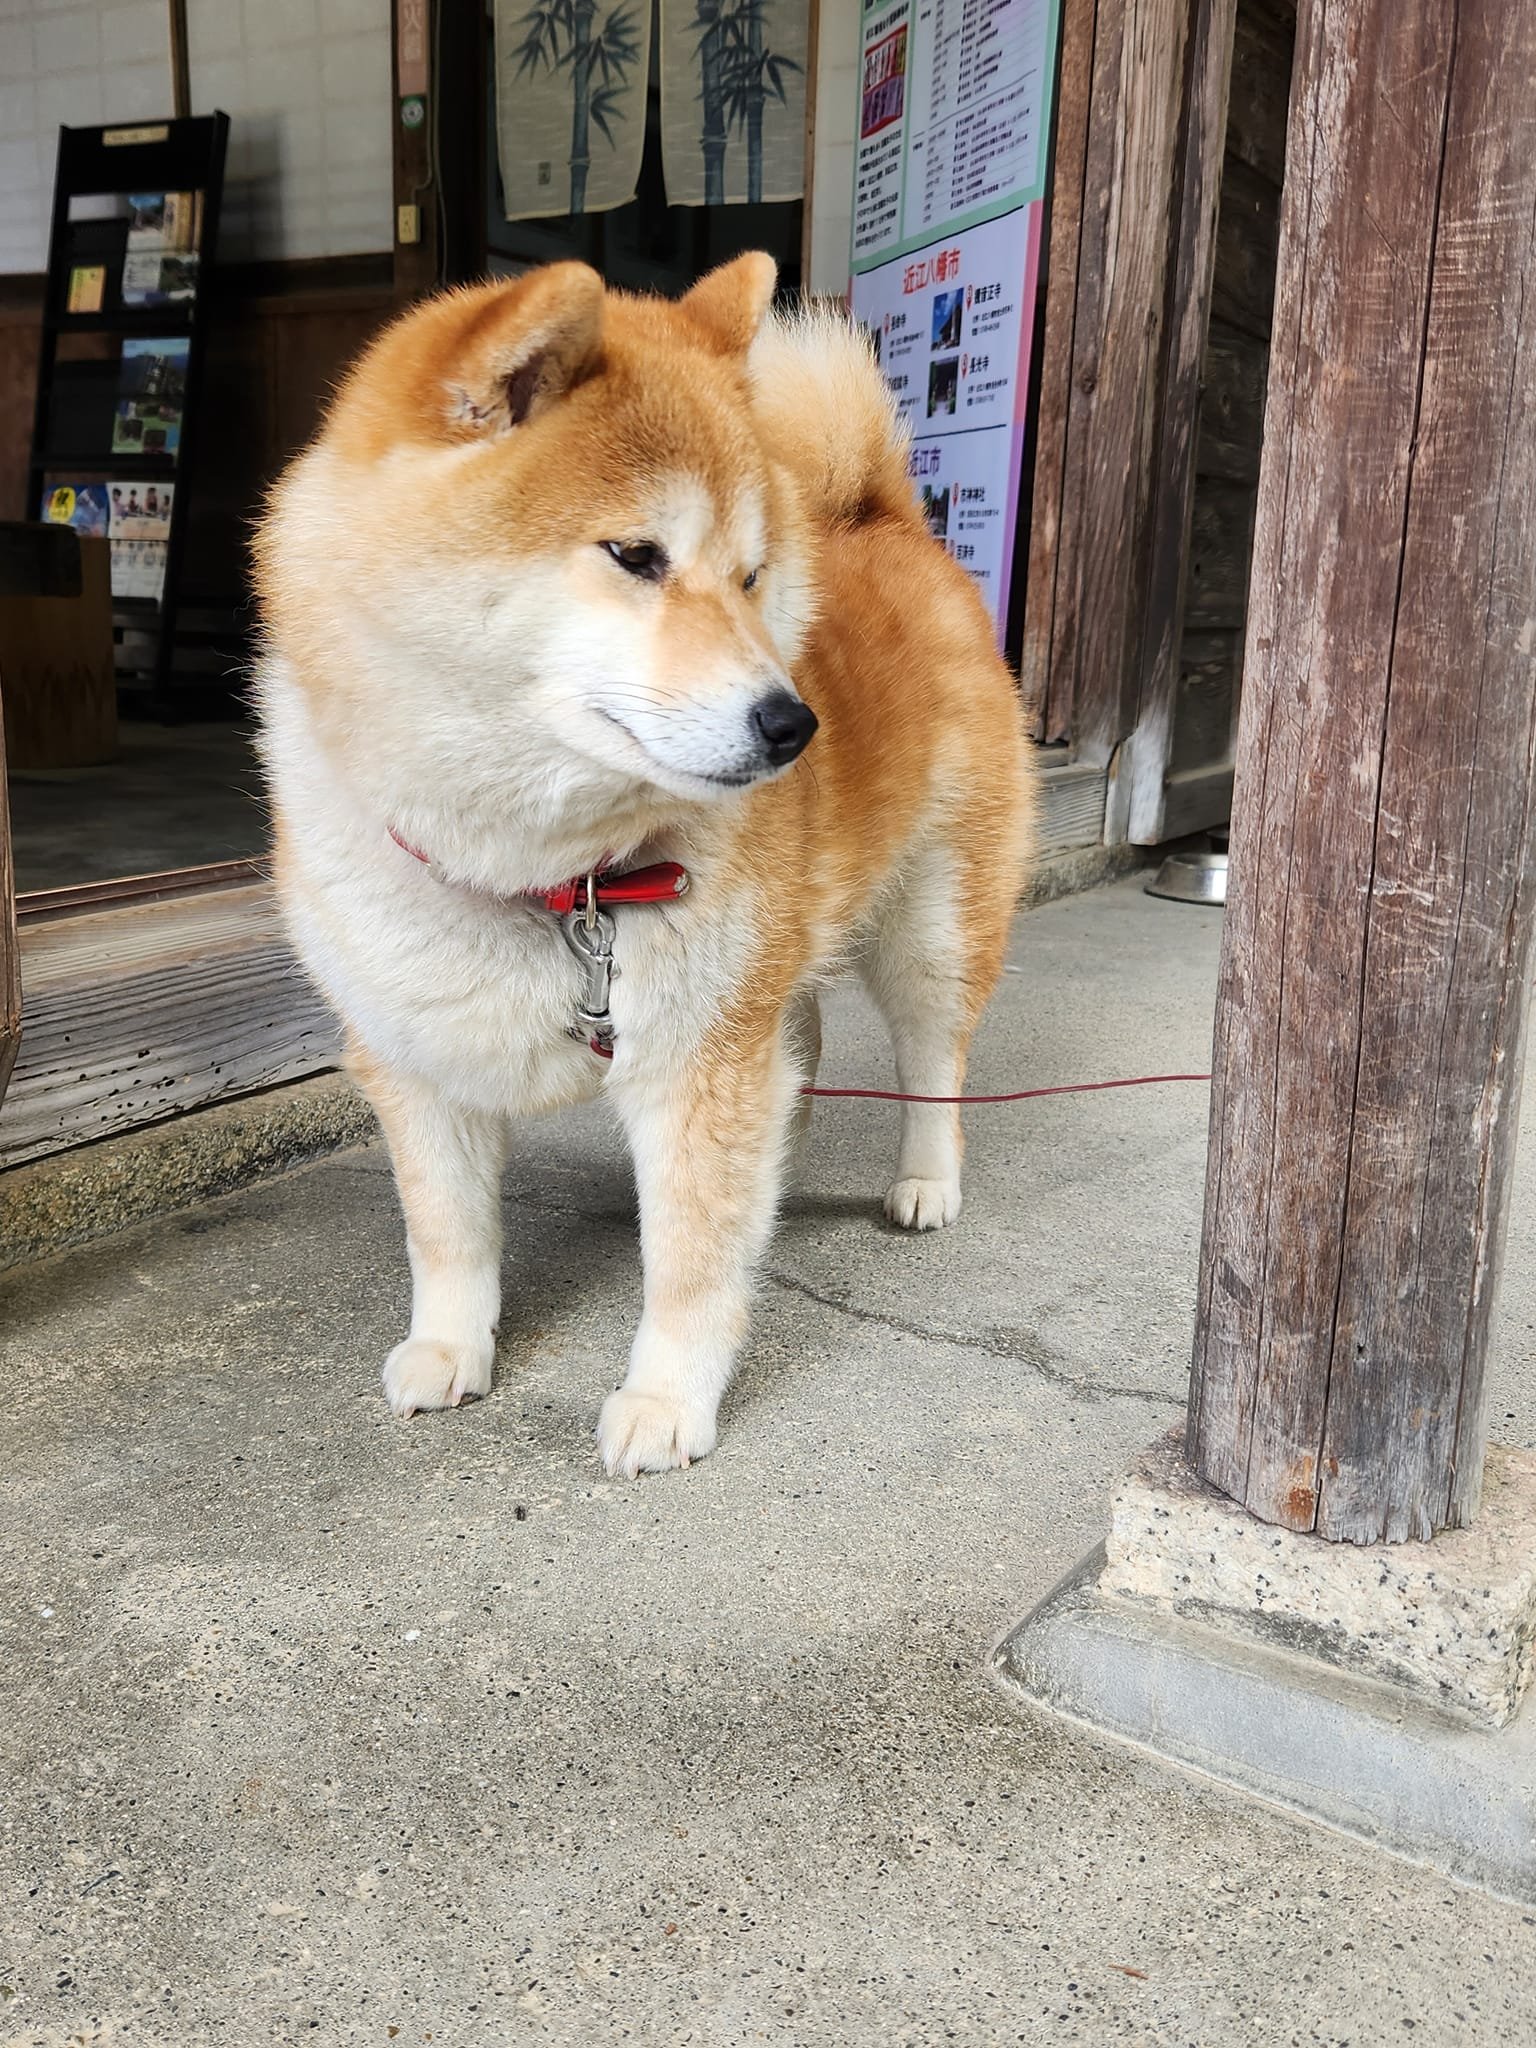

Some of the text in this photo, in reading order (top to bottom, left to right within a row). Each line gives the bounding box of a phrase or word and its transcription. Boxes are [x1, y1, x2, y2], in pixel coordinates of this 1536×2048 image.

[903, 249, 961, 294] 近江八幡市
